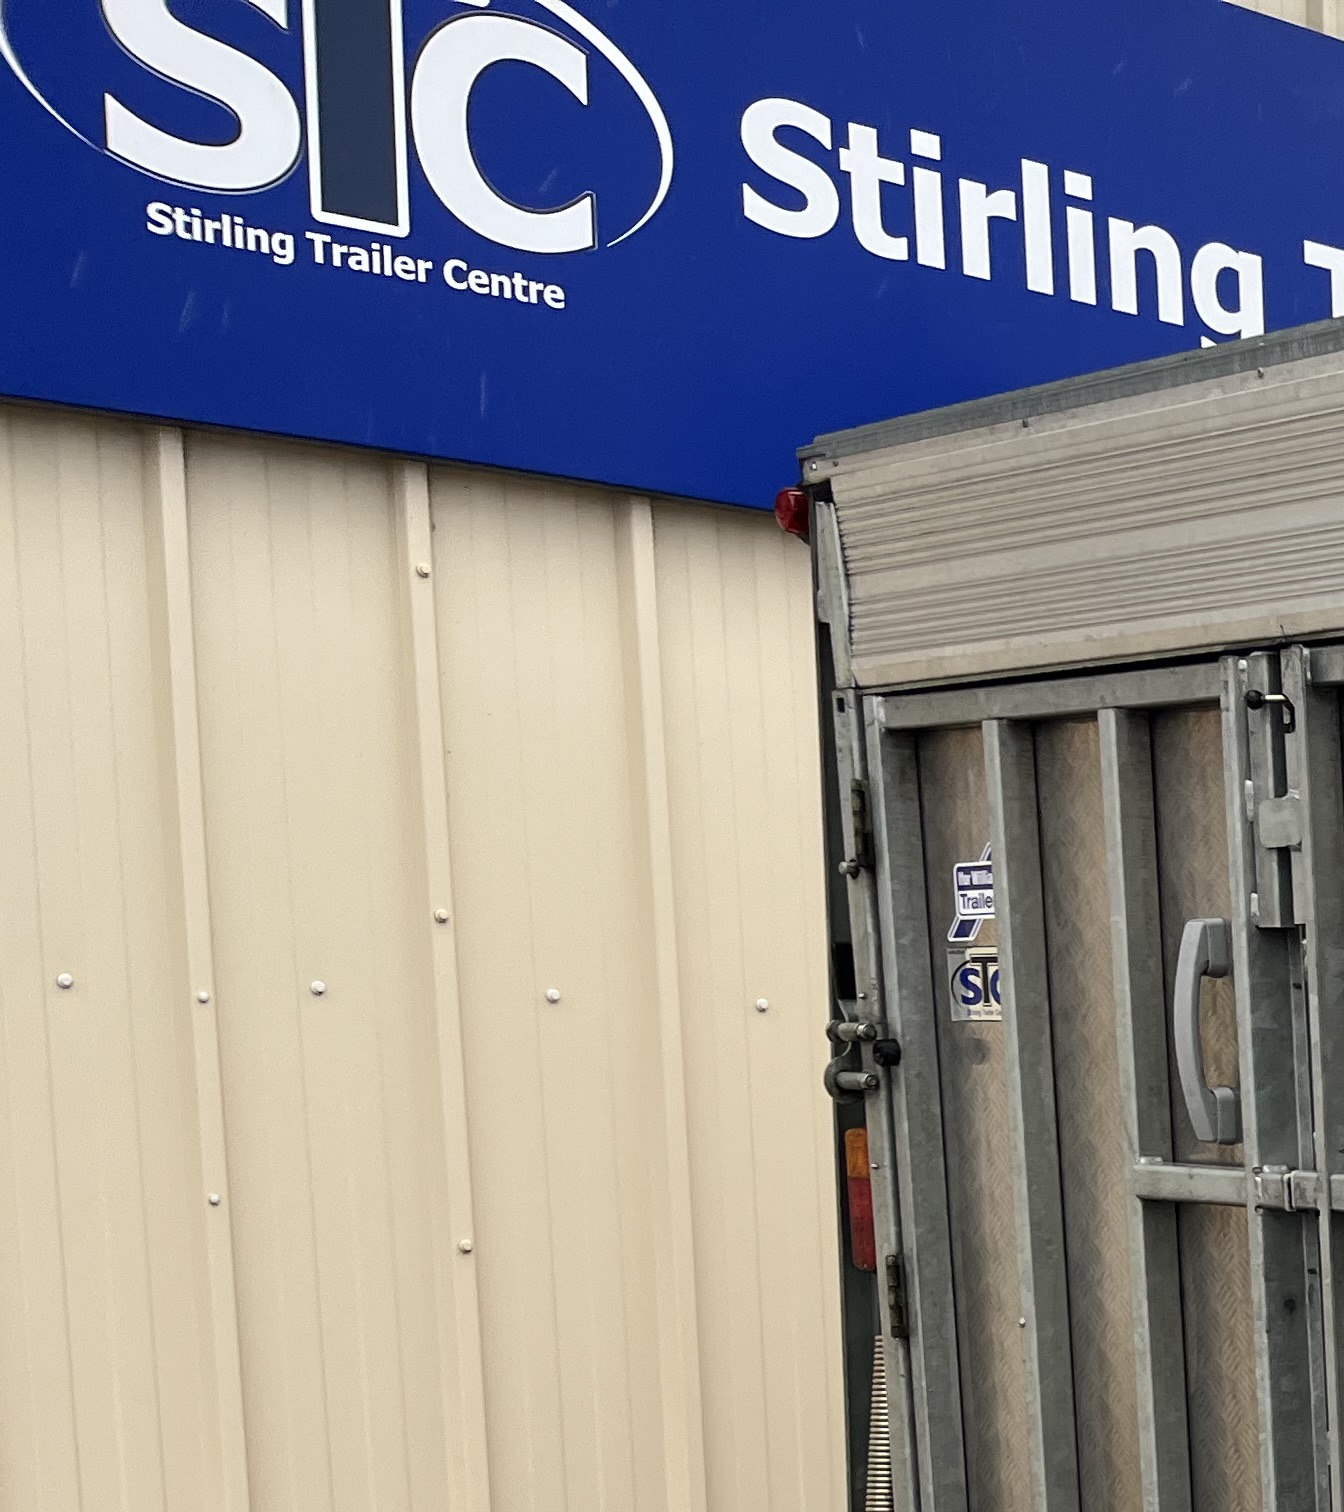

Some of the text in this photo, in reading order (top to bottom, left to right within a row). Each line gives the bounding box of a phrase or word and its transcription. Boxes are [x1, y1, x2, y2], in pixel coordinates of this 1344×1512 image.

[147, 201, 565, 309] Stirling Trailer Centre
[739, 97, 1265, 349] Stirling
